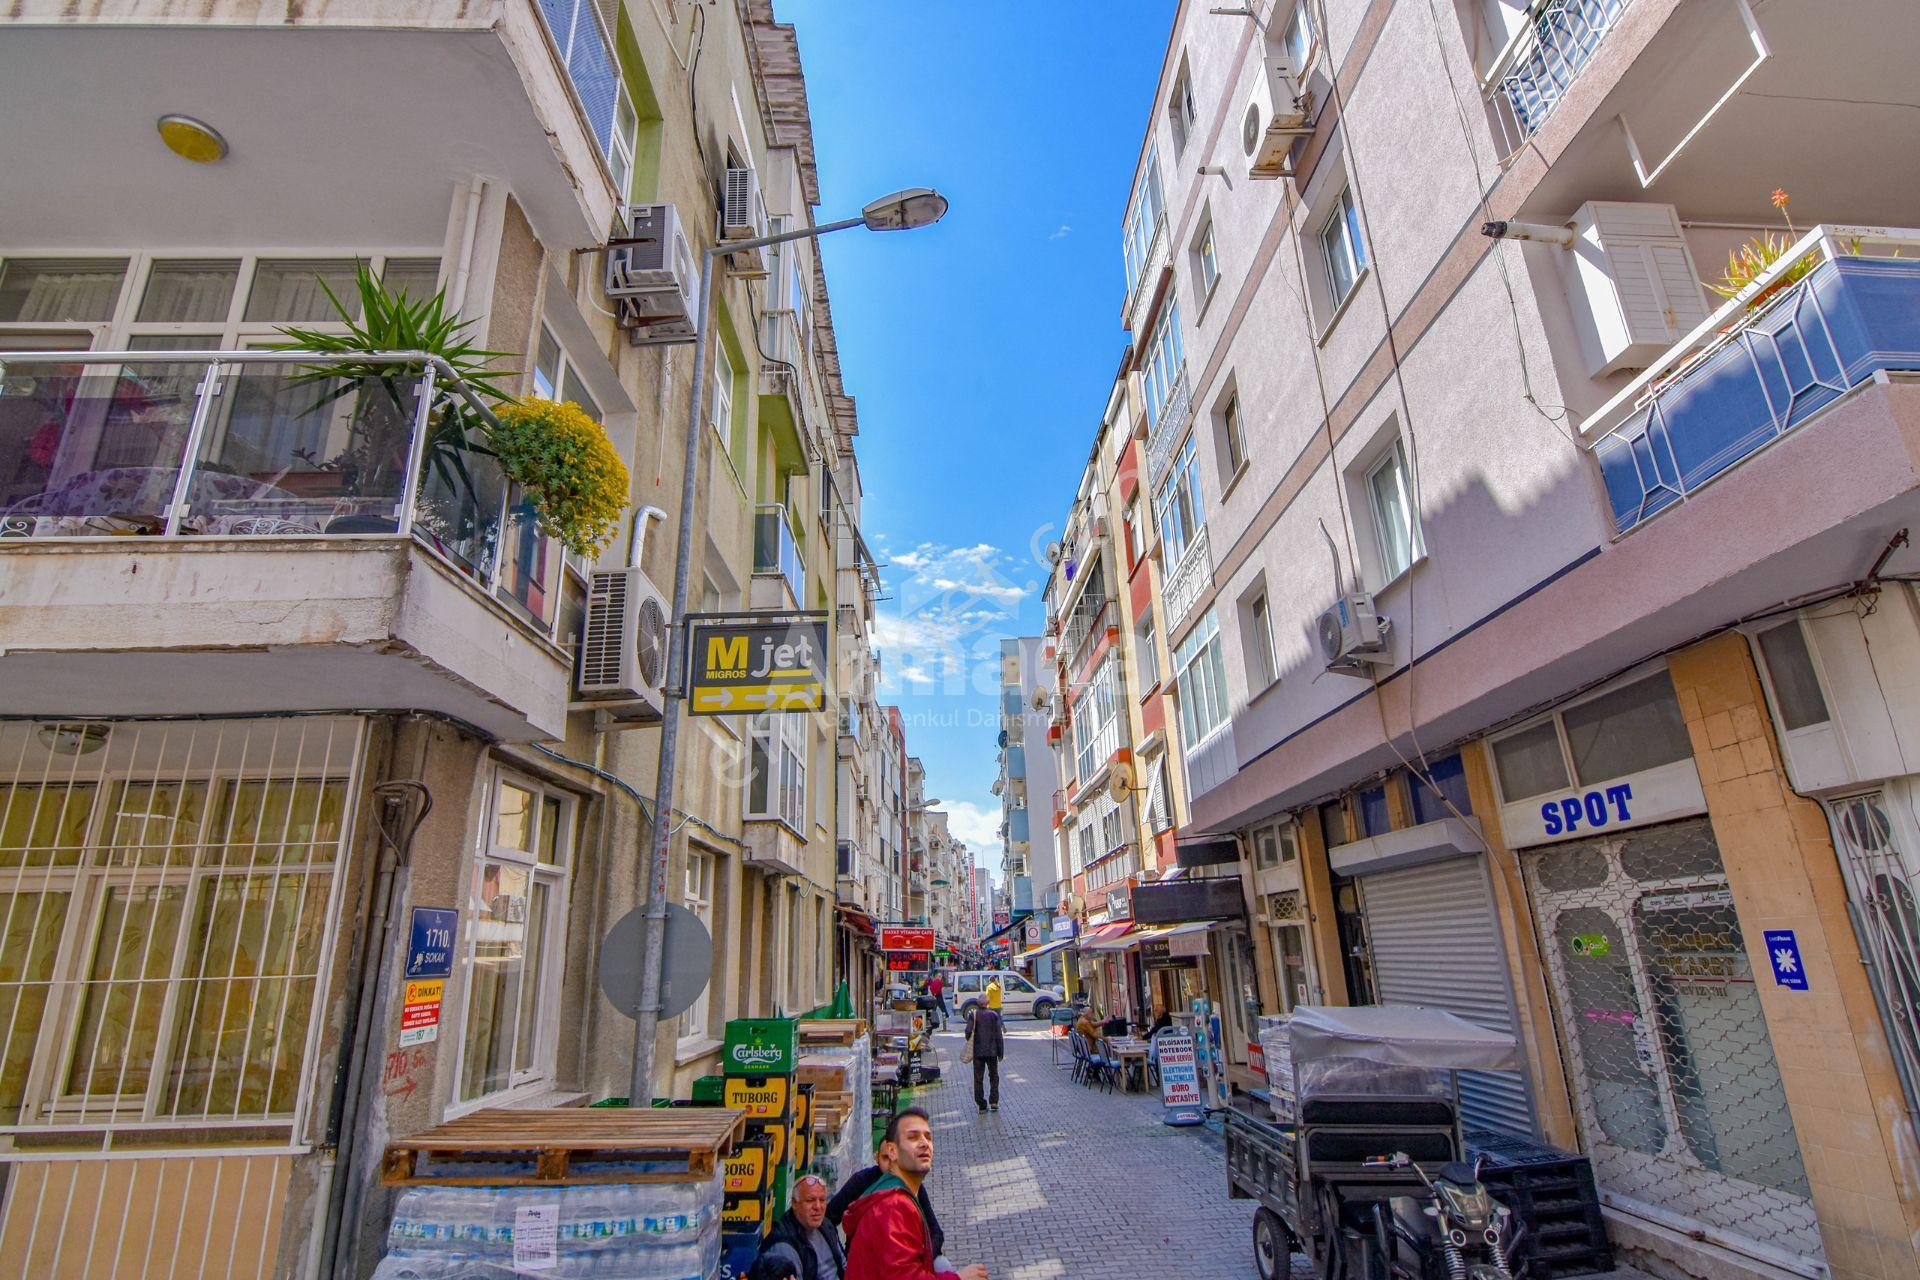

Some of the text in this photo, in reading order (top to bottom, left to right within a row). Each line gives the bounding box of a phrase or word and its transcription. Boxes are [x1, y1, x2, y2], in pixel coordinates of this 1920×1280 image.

[706, 634, 813, 678] M jet
[1541, 783, 1633, 836] SPOT
[426, 929, 450, 948] 1710.
[424, 952, 446, 963] SOKAK
[1159, 1039, 1192, 1047] BİLGİSAYAR
[732, 1043, 783, 1061] Carlsberg
[1159, 1047, 1193, 1055] NOTEBOOK
[1171, 1083, 1190, 1093] BÜRO
[732, 1092, 778, 1104] TUBORG
[1164, 1093, 1199, 1104] KIRTASİYE
